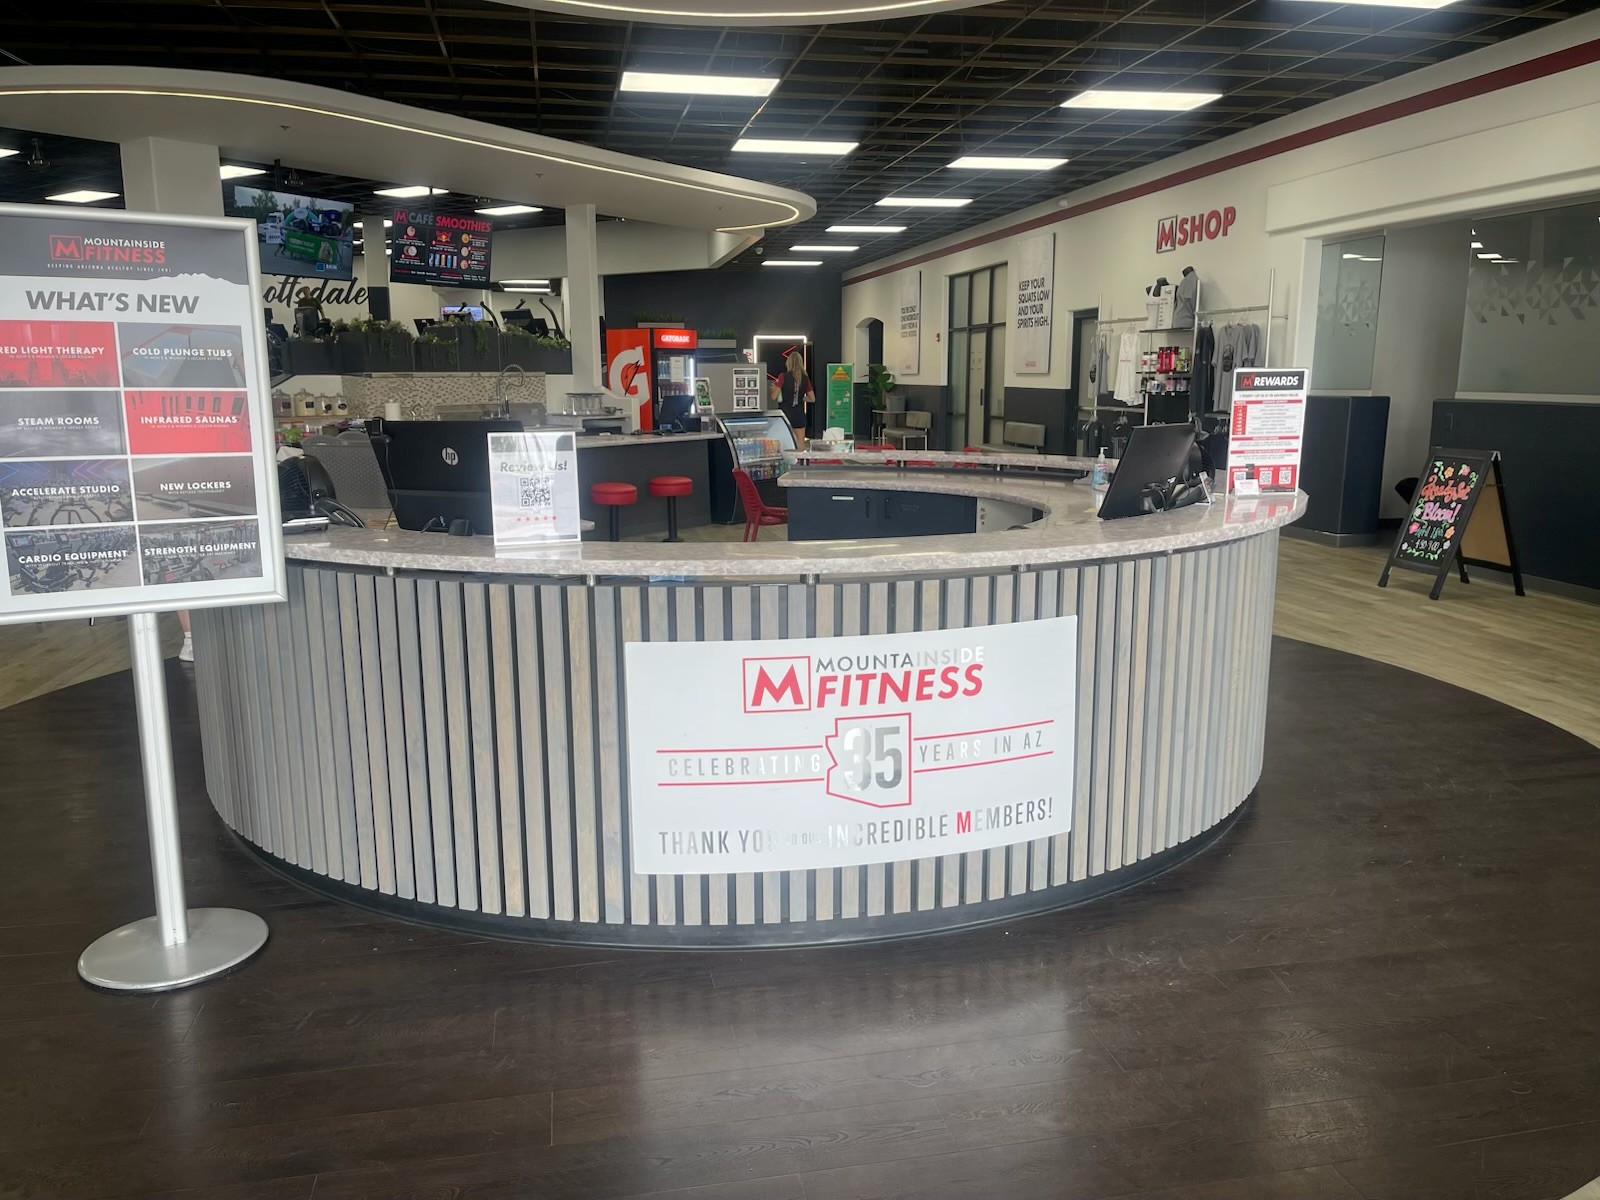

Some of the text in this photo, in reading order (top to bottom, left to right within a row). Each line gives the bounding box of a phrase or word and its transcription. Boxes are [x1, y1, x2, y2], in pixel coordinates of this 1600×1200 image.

[408, 212, 434, 225] CAFÉ
[436, 216, 491, 232] SMOOTHIES
[1178, 206, 1236, 246] SHOP
[84, 238, 165, 248] MOUNTAINSIDE
[85, 246, 166, 264] FITNESS
[1019, 278, 1045, 291] KEEP YOUR
[26, 290, 200, 314] WHAT'S NEW
[1018, 290, 1050, 304] SQUATS LOW
[1018, 304, 1044, 316] AND YOUR
[1017, 316, 1049, 329] SPIRITS HIGH.
[21, 346, 53, 354] LIGHT
[56, 347, 105, 355] THERAPY
[1254, 376, 1298, 386] REWARDS
[500, 461, 545, 472] Review
[12, 485, 119, 496] ACCELERATE STUDIO
[187, 481, 231, 489] LOCKERS
[1421, 502, 1462, 523] Bloom!
[144, 546, 197, 556] STRENGTH
[200, 542, 256, 552] EQUIPMENT
[19, 550, 127, 564] CARDIO EQUIPMENT
[751, 646, 984, 706] M MOUNTAINSIDE
[817, 664, 984, 708] FITNESS
[668, 726, 1042, 791] CELEBRATING 35 YEARS IN AZ
[659, 830, 729, 855] THANK
[828, 814, 948, 848] INCREDIBLE
[956, 797, 1052, 835] MEMBERS!
